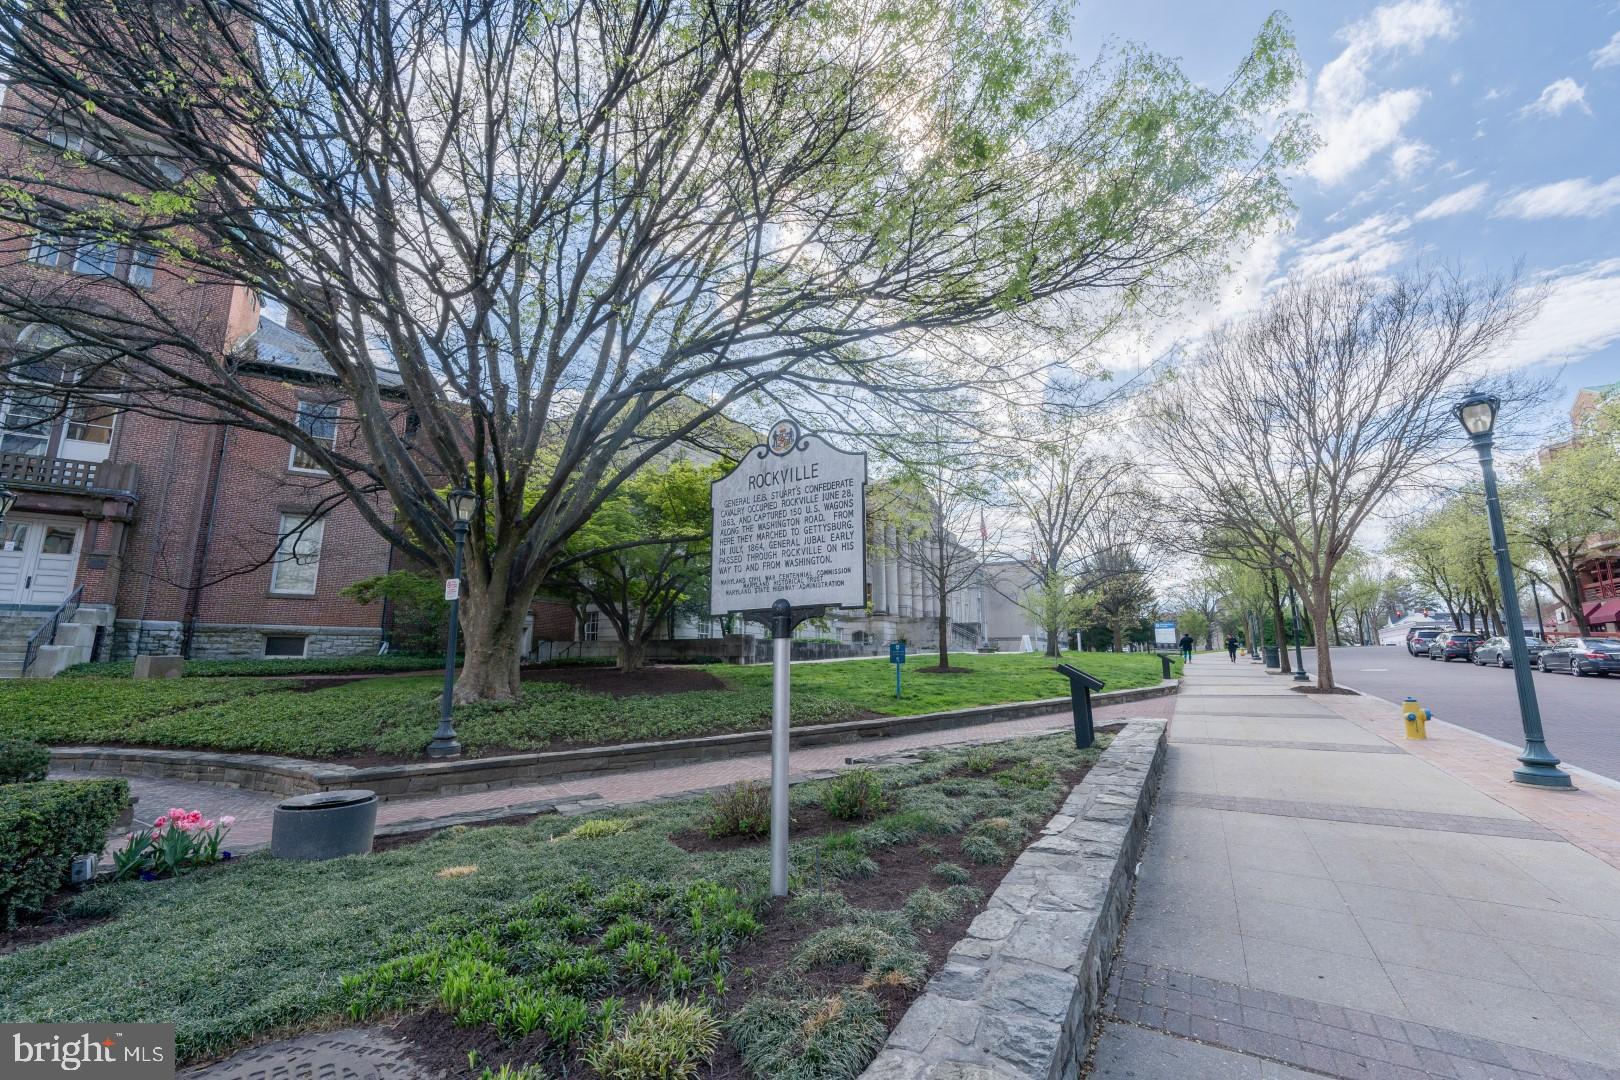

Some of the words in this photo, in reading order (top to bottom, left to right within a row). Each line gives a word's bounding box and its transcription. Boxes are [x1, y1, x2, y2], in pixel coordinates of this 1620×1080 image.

[749, 463, 819, 490] ROCKVILLE
[720, 506, 745, 518] CAVALRY
[747, 501, 778, 514] OCCUPIED
[781, 494, 819, 508] ROCKVILLE
[822, 490, 840, 502] JUNE
[841, 488, 854, 499] 28,
[724, 496, 750, 508] GENERAL
[771, 485, 801, 499] STUART'S
[804, 478, 854, 494] CONFEDERATE
[720, 526, 740, 537] ALONG
[741, 524, 754, 533] THE
[757, 517, 800, 531] WASHINGTON
[833, 509, 854, 521] FROM
[739, 515, 752, 525] AND
[753, 510, 788, 522] CAPTURED
[790, 507, 802, 517] 150
[823, 498, 854, 512] WAGONS
[719, 536, 735, 546] HERE
[737, 533, 753, 544] THEY
[756, 529, 788, 541] MARCHED
[790, 527, 800, 537] TO
[719, 548, 726, 556] IN
[768, 537, 801, 550] GENERAL
[804, 534, 826, 546] JUBAL
[830, 530, 854, 542] EARLY
[719, 554, 743, 565] PASSED
[746, 550, 778, 562] THROUGH
[781, 544, 822, 558] ROCKVILLE
[826, 543, 838, 553] ON
[841, 541, 854, 551] HIS
[719, 565, 731, 575] WAY
[733, 564, 742, 574] TO
[745, 561, 760, 573] AND
[762, 560, 781, 571] FROM
[784, 554, 833, 568] WASHINGTON.
[764, 574, 776, 582] WAR
[778, 570, 813, 580] CENTENNIAL
[816, 567, 852, 576] COMMISSION
[798, 579, 845, 590] ADMINISTRATION
